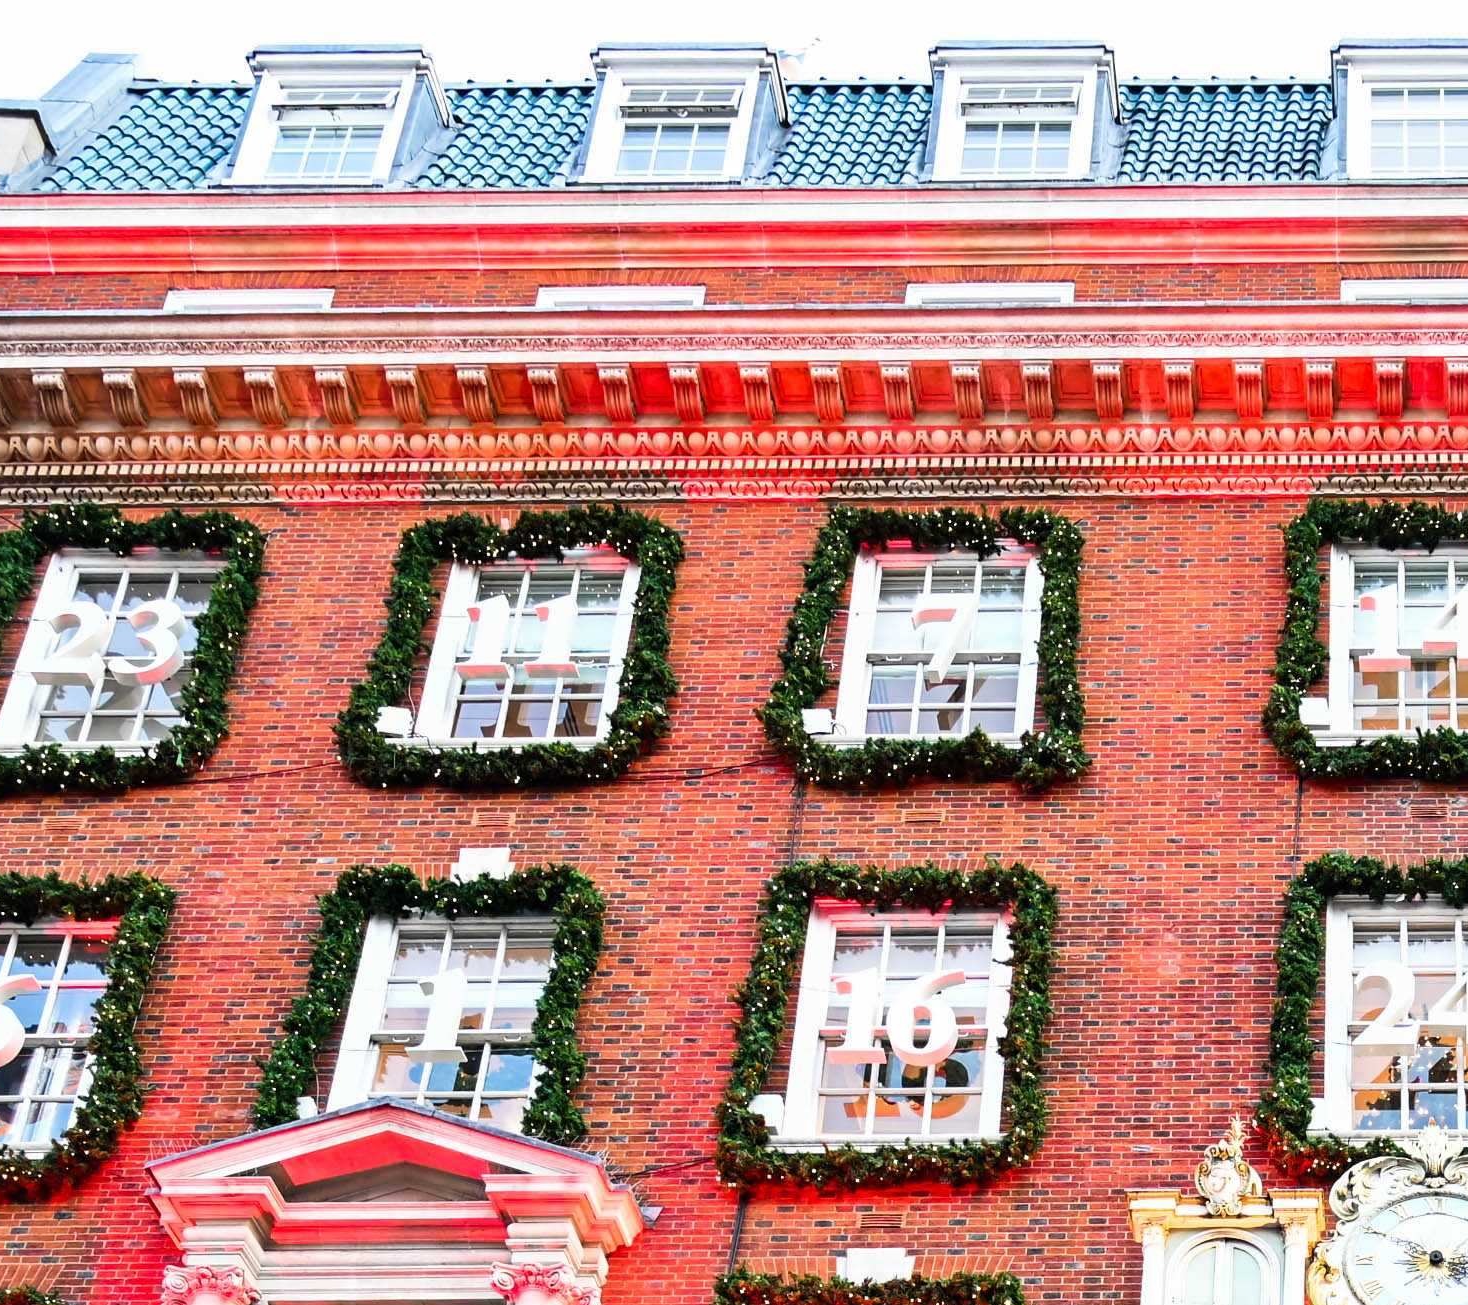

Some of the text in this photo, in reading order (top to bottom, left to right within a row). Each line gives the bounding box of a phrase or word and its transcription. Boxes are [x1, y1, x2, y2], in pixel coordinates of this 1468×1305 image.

[32, 600, 184, 686] 23
[457, 594, 577, 679] 11
[912, 592, 979, 682] 7
[405, 968, 468, 1063] 1
[828, 968, 965, 1066] 16
